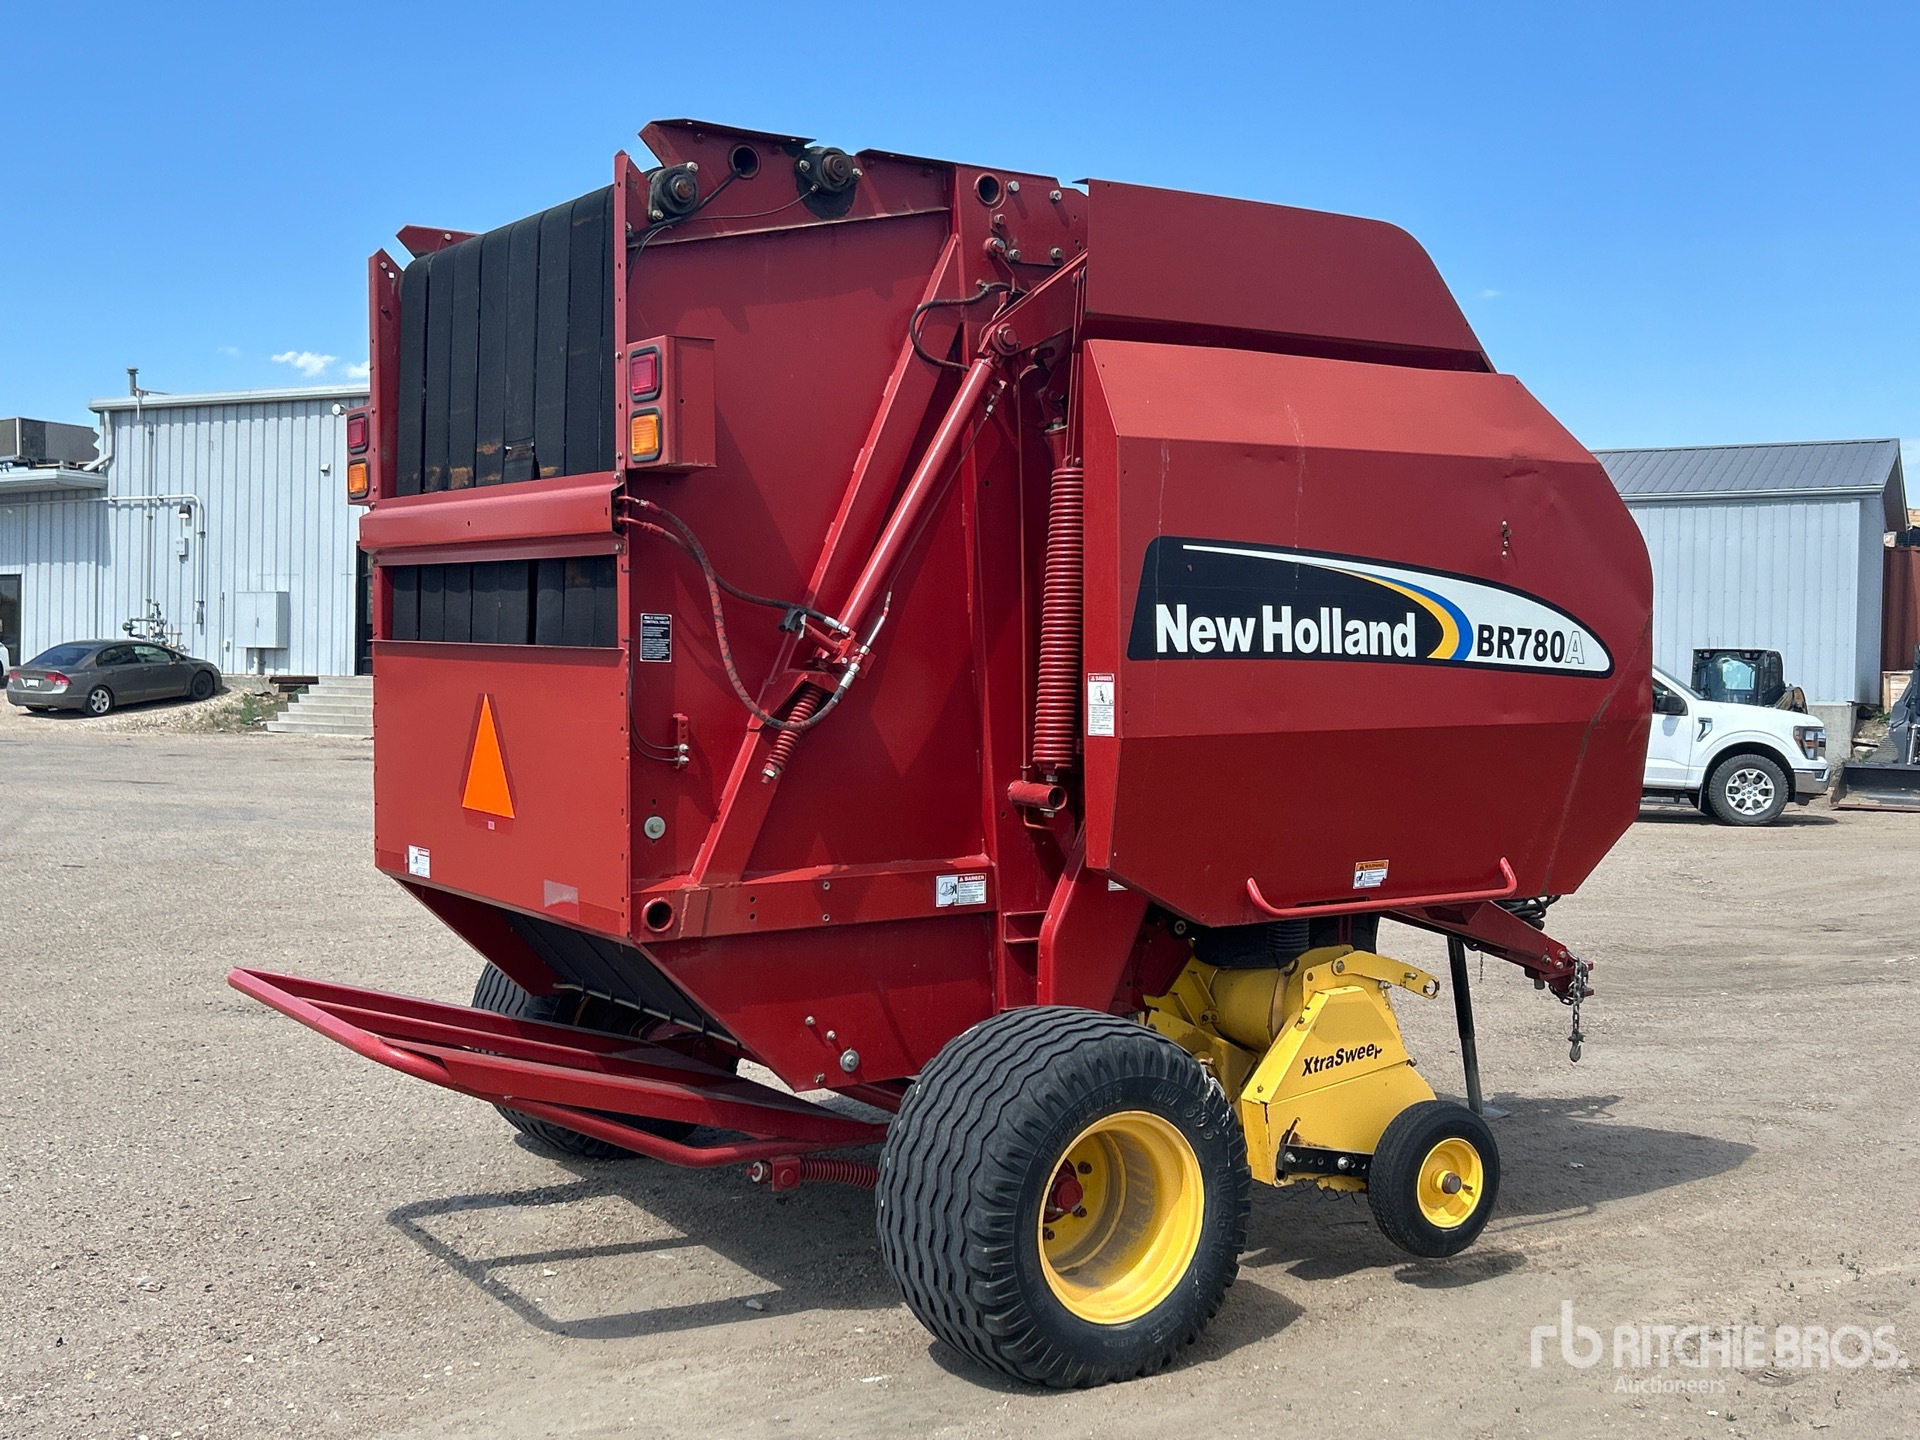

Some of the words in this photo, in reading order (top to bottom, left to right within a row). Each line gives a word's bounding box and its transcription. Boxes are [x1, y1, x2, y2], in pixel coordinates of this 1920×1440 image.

[1156, 604, 1256, 653] New
[1263, 605, 1415, 657] Holland
[1477, 624, 1585, 664] BR780A
